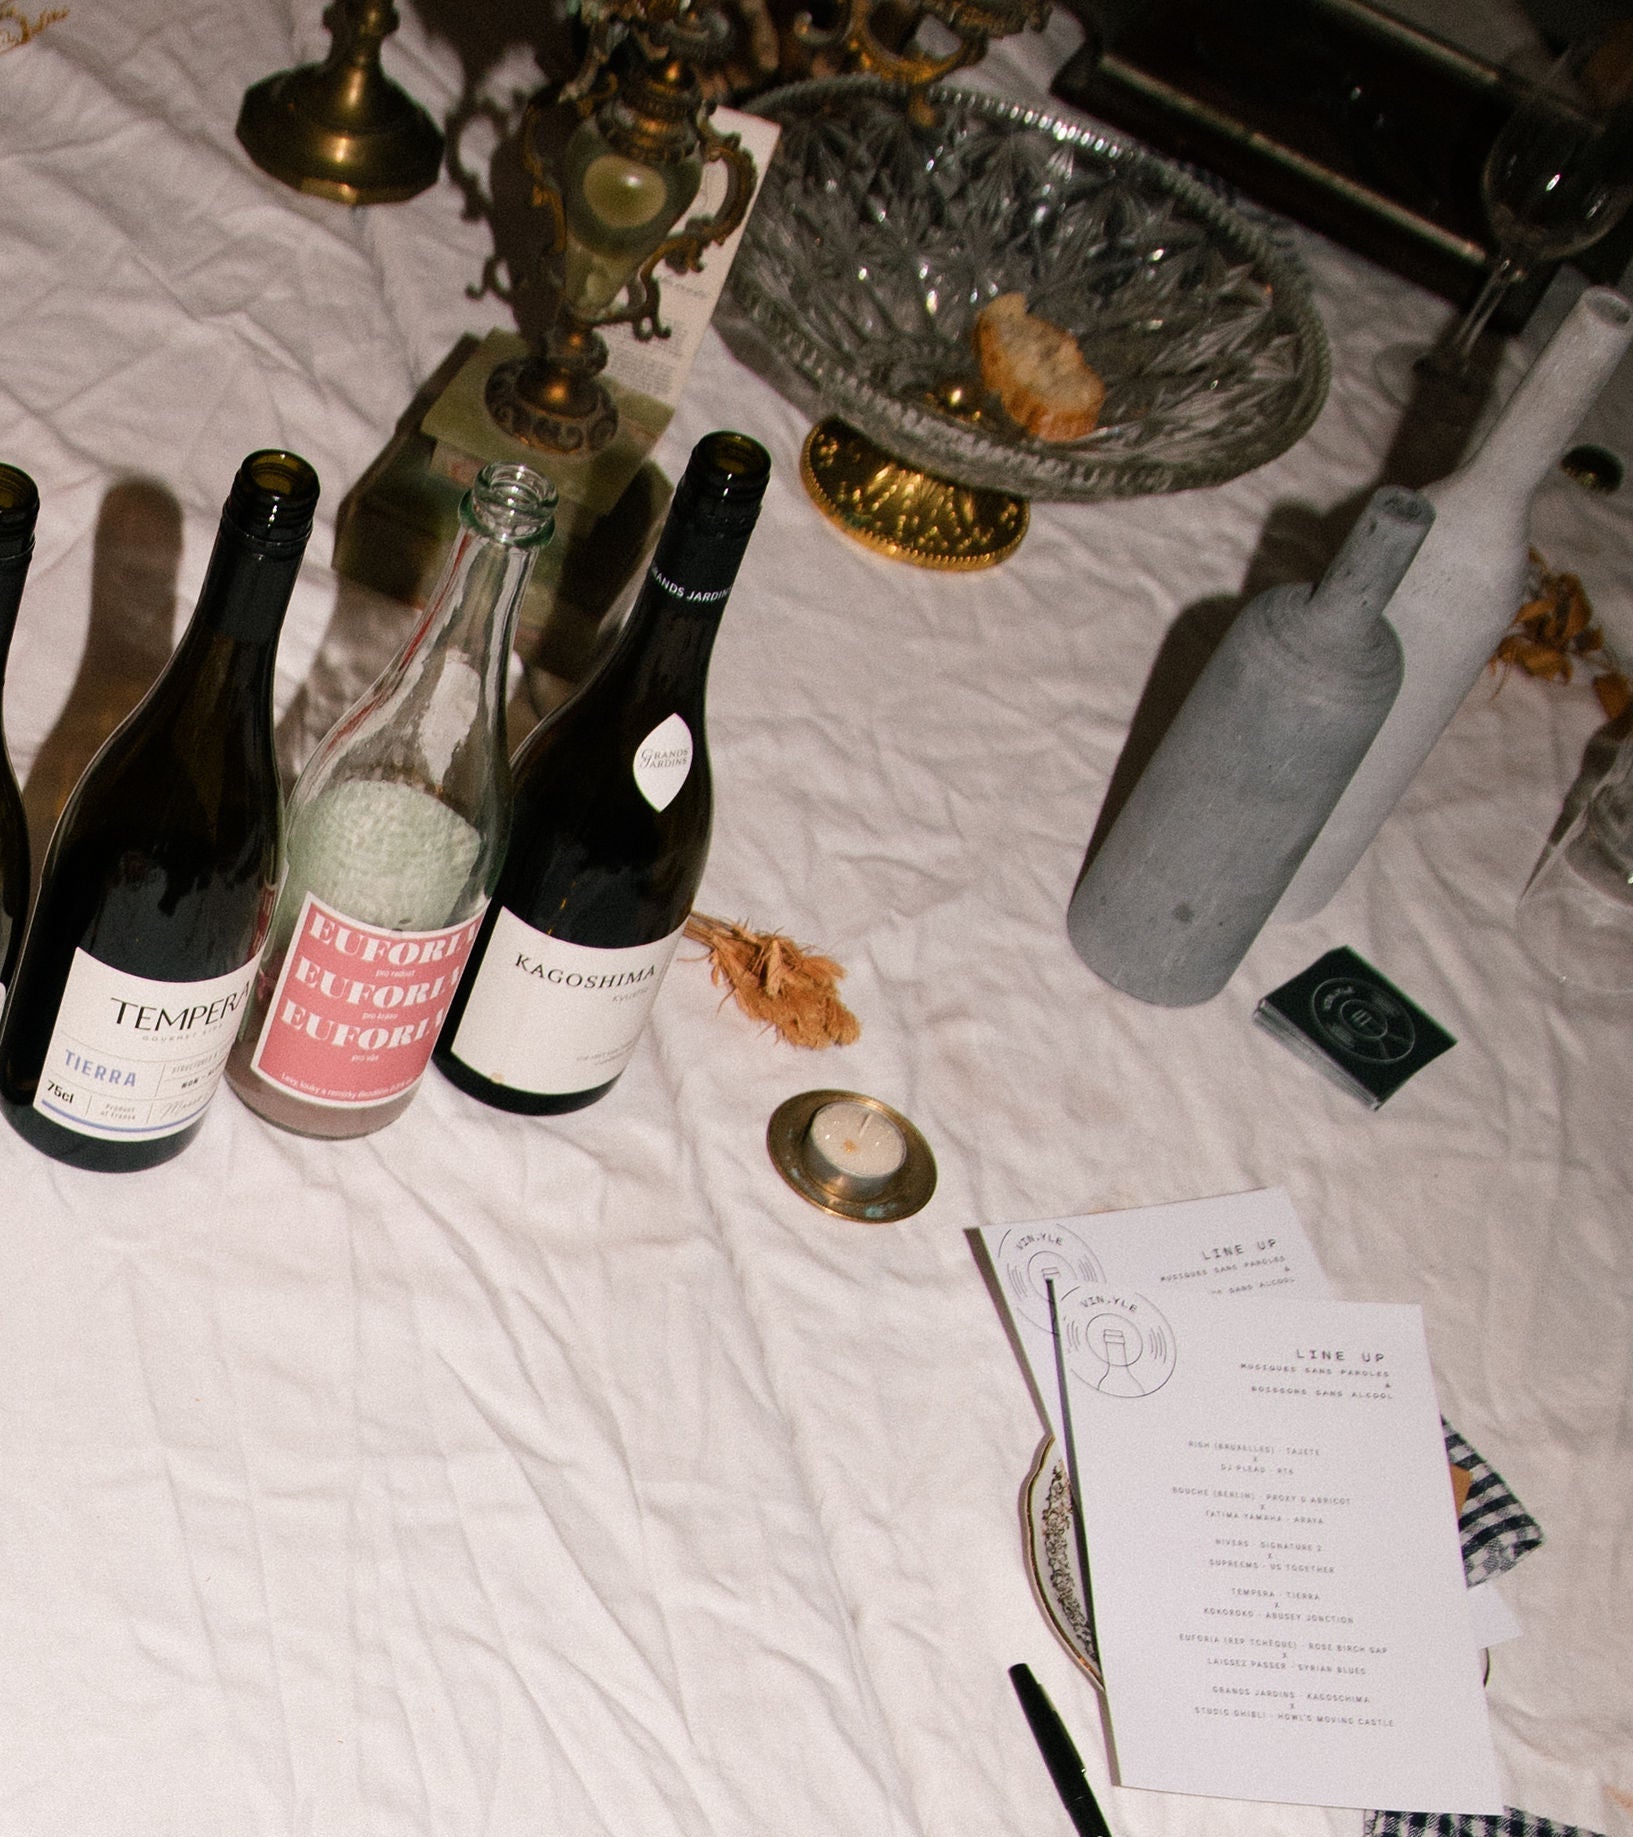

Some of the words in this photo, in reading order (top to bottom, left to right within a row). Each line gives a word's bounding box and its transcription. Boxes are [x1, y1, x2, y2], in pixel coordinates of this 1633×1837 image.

[515, 953, 656, 989] KAGOSHIMA
[110, 981, 251, 1031] TEMPERA
[66, 1049, 137, 1087] TIERRA
[47, 1079, 74, 1104] 75cl
[1201, 1244, 1245, 1261] LINE
[1257, 1238, 1277, 1251] UP
[1160, 1269, 1208, 1282] MUSIQUES
[1214, 1263, 1238, 1275] SANS
[1296, 1349, 1345, 1361] LINE
[1362, 1352, 1385, 1363] UP
[1240, 1363, 1297, 1373] MUSIQUES
[1304, 1367, 1332, 1375] SANS
[1340, 1369, 1390, 1378] PAROLES
[1251, 1386, 1307, 1396] BOISSONS
[1315, 1389, 1343, 1397] SANS
[1351, 1392, 1393, 1400] ALCOOL
[1231, 1587, 1275, 1598] TEMPERA
[1286, 1591, 1320, 1600] TIERRA
